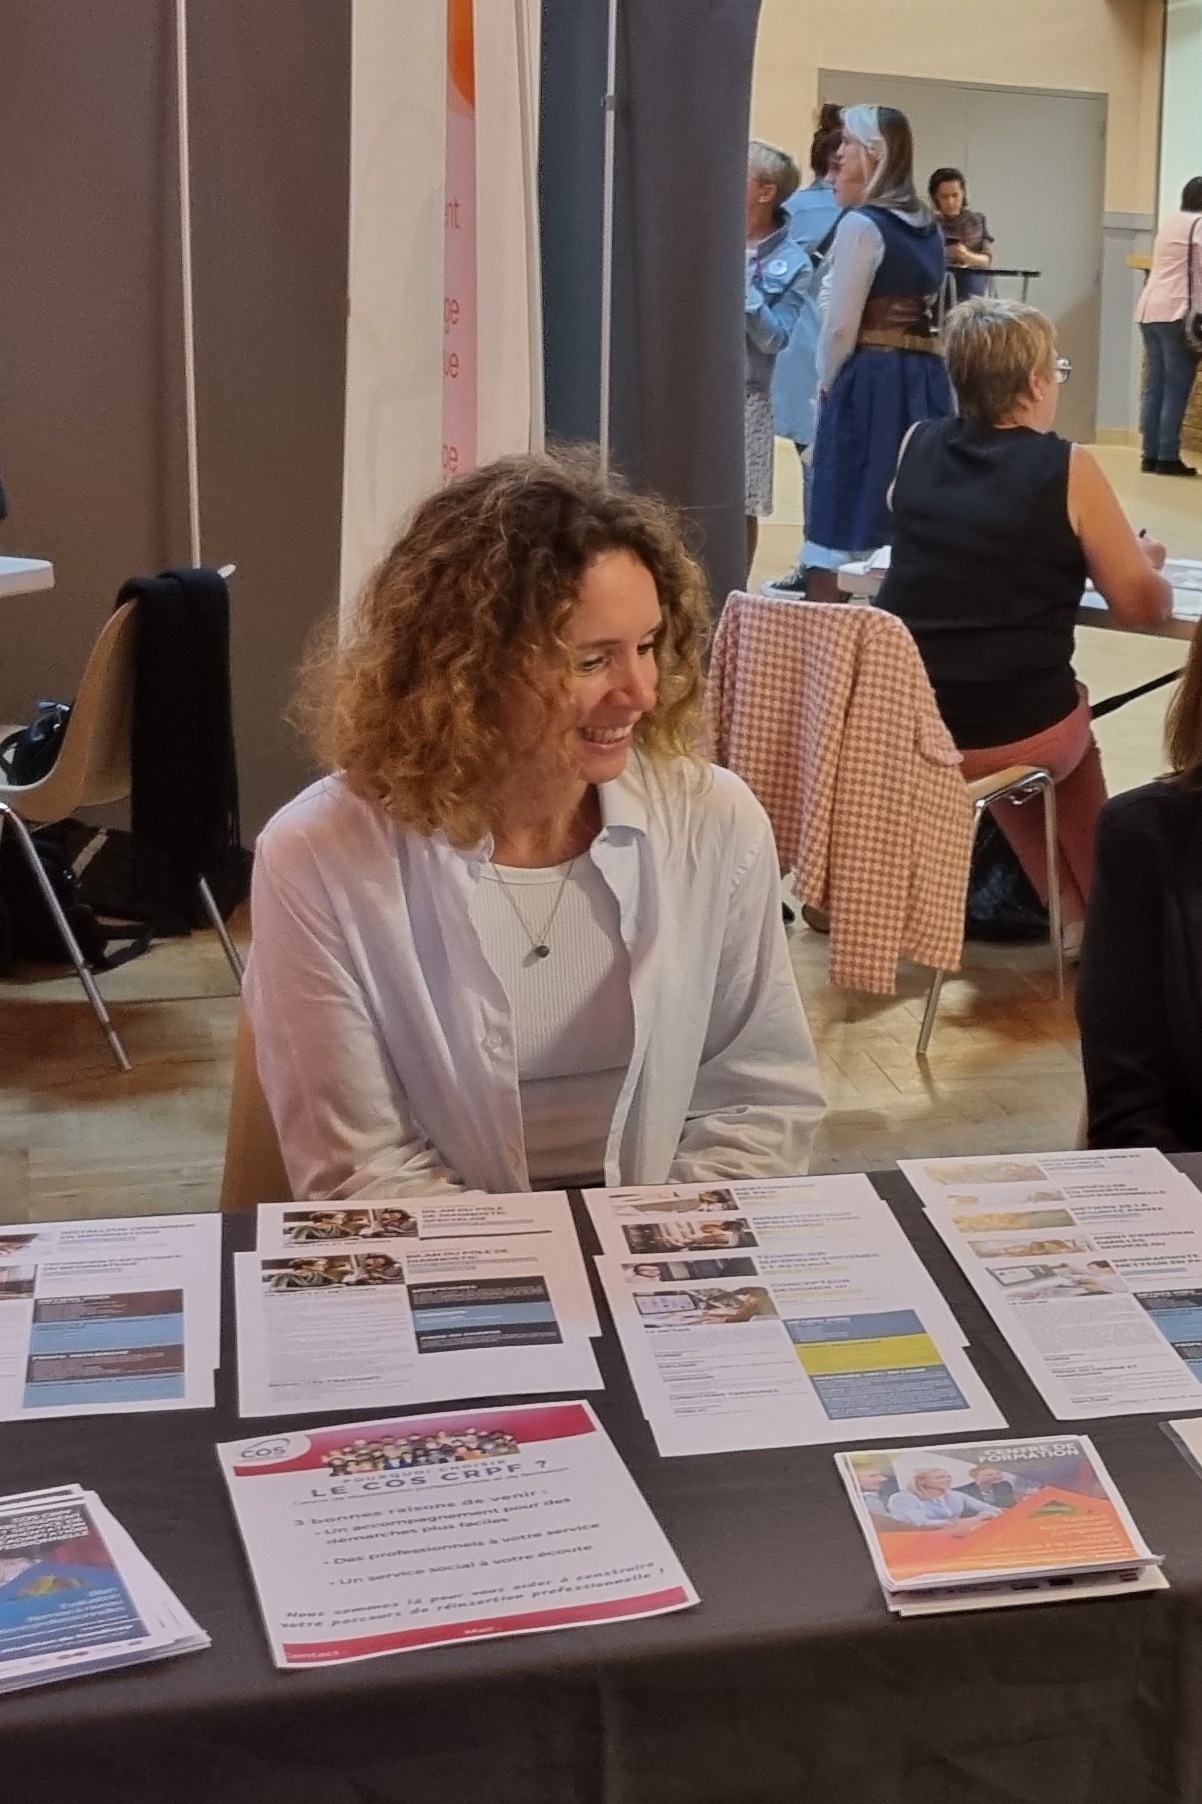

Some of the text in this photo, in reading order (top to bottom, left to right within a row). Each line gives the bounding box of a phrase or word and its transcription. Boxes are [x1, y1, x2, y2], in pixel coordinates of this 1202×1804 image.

[241, 1446, 286, 1458] COS
[978, 1449, 1079, 1463] FORMATION
[984, 1442, 1077, 1456] CENTRE DE
[311, 1460, 547, 1497] LE COS CRPF ?
[343, 1460, 506, 1484] POURQUOI CHOISIR
[311, 1511, 382, 1524] bonnes
[388, 1502, 456, 1515] raisons
[461, 1498, 484, 1506] de
[490, 1490, 537, 1502] venir
[324, 1527, 348, 1535] Un
[353, 1508, 499, 1531] accompagnement
[503, 1502, 539, 1514] pour
[544, 1497, 571, 1506] des
[326, 1517, 509, 1544] démarches plus faciles
[333, 1554, 364, 1565] Des
[369, 1540, 485, 1562] professionnels
[502, 1531, 543, 1543] votre
[546, 1522, 600, 1536] service
[339, 1576, 364, 1585] Un
[368, 1567, 425, 1582] service
[429, 1562, 475, 1573] social
[493, 1553, 533, 1565] votre
[537, 1543, 593, 1558] écoute
[280, 1619, 323, 1629] votre
[331, 1610, 402, 1627] parcours
[410, 1606, 429, 1615] de
[437, 1593, 524, 1612] réinsertion
[531, 1573, 651, 1599] professionnelle
[286, 1610, 325, 1618] Nous
[334, 1602, 399, 1615] sommes
[429, 1592, 465, 1604] pour
[471, 1586, 505, 1596] vous
[512, 1578, 553, 1591] aider
[576, 1560, 655, 1581] construire
[286, 1650, 340, 1659] Contact
